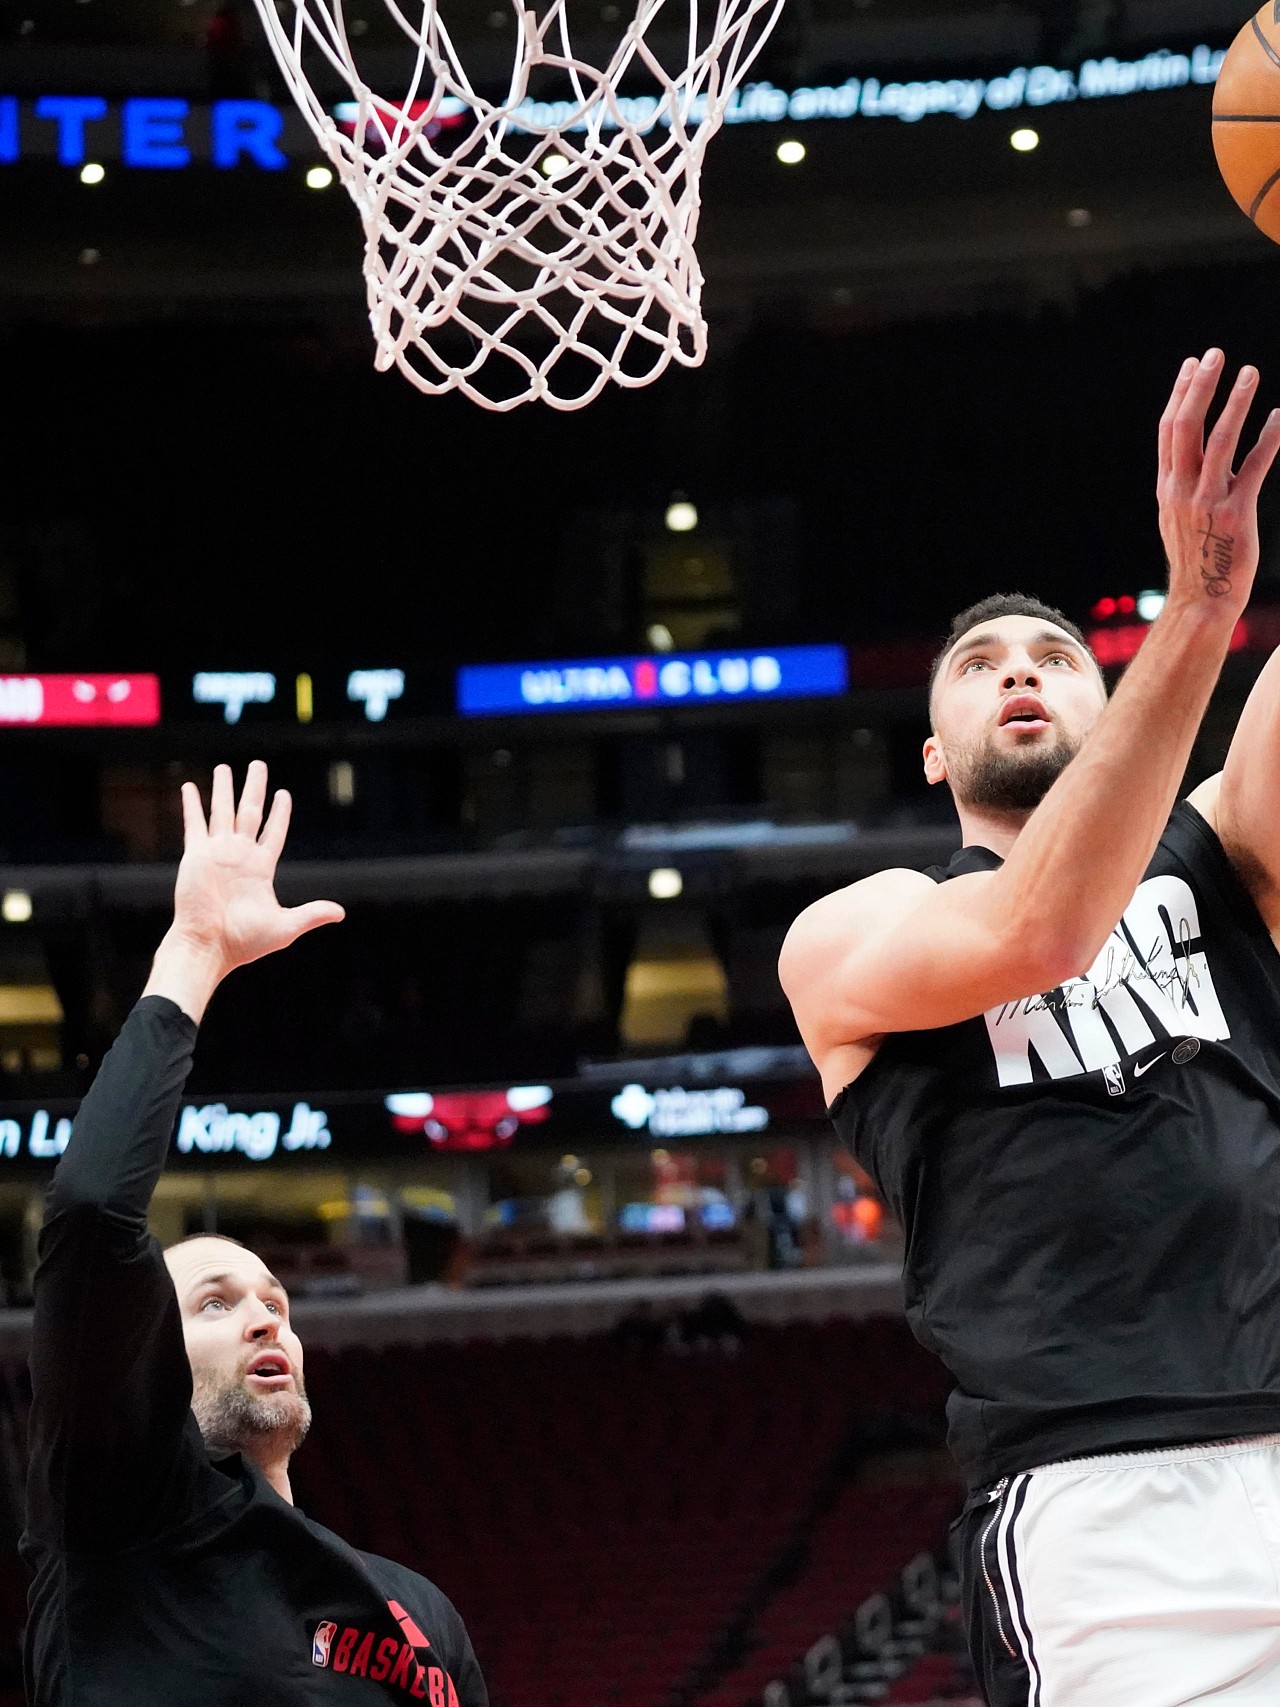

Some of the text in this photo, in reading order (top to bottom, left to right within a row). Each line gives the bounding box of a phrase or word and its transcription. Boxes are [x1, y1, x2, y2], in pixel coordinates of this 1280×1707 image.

[788, 77, 860, 120] and
[861, 77, 986, 122] Legacy
[985, 66, 1028, 110] of
[1079, 48, 1190, 99] Martin
[659, 656, 782, 698] CLUB
[177, 1102, 281, 1161] King
[281, 1102, 332, 1152] Jr.
